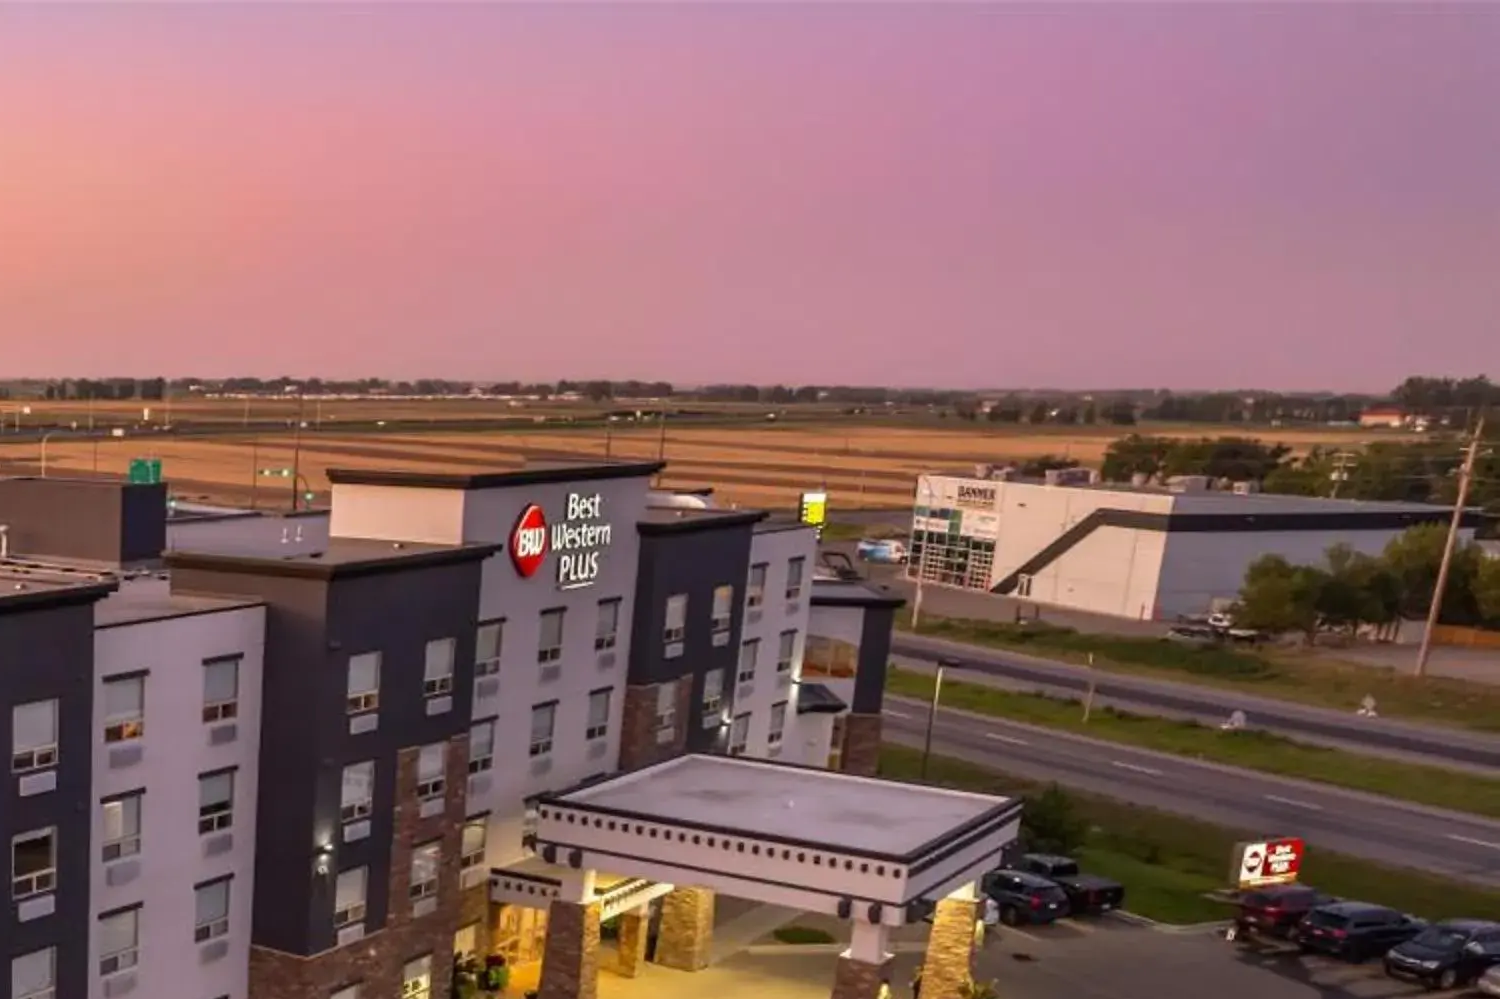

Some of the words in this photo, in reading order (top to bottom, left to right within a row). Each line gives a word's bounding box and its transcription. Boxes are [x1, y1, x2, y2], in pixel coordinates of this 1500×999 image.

[567, 493, 600, 520] Best
[517, 527, 545, 557] BW
[551, 523, 611, 551] Western
[560, 551, 599, 582] PLUS
